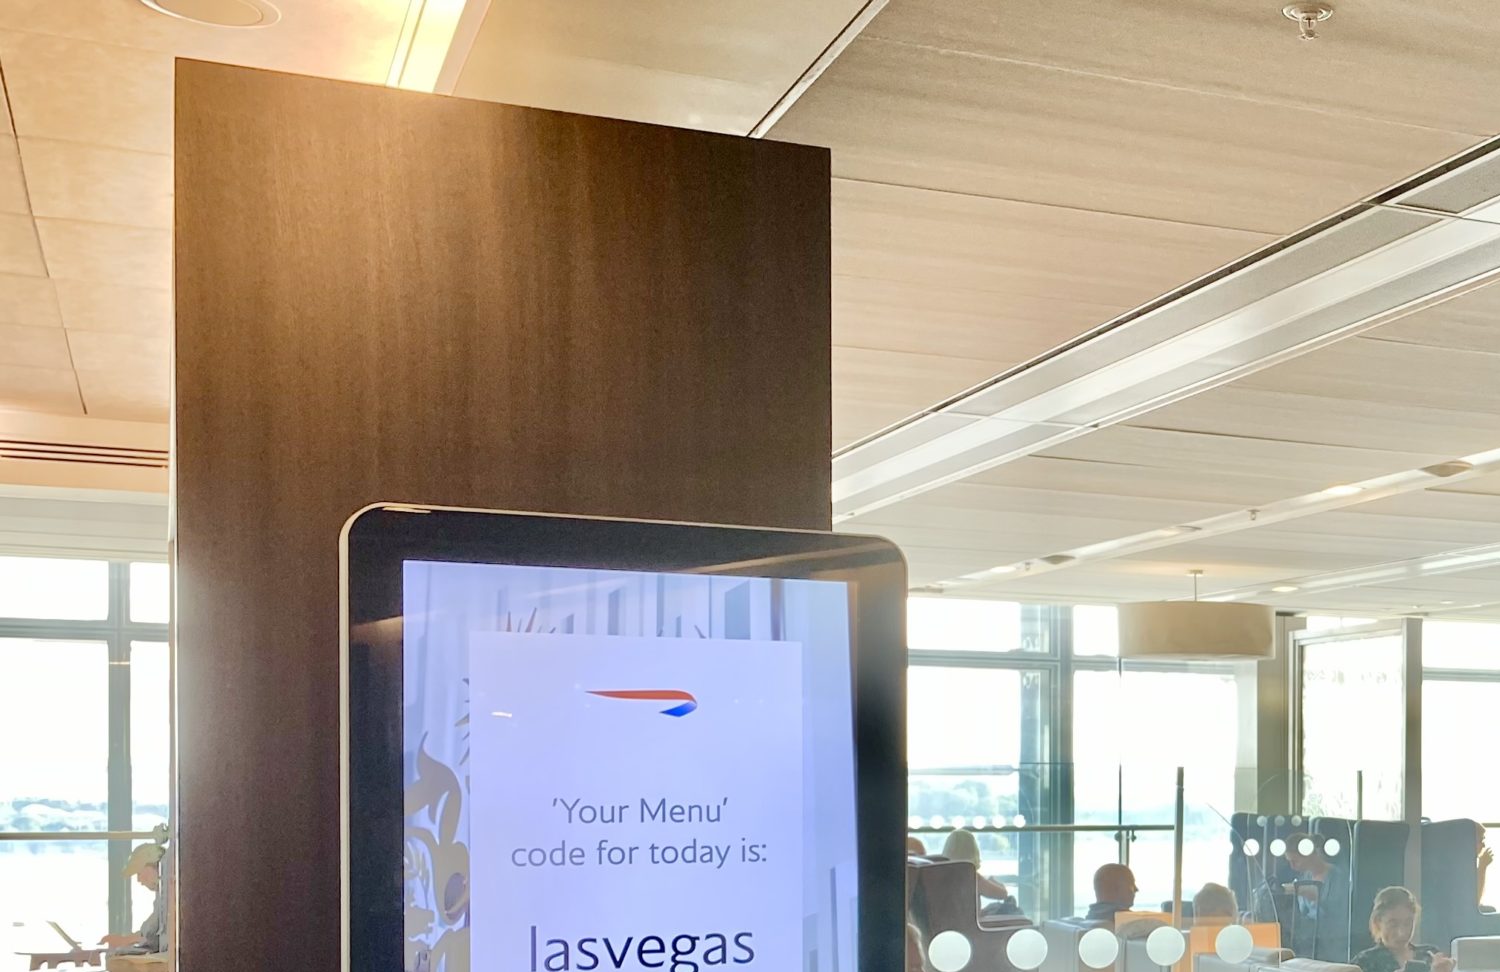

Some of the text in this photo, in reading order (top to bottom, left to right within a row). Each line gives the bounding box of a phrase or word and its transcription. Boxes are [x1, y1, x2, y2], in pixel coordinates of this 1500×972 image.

[511, 837, 767, 869] code for today is:
